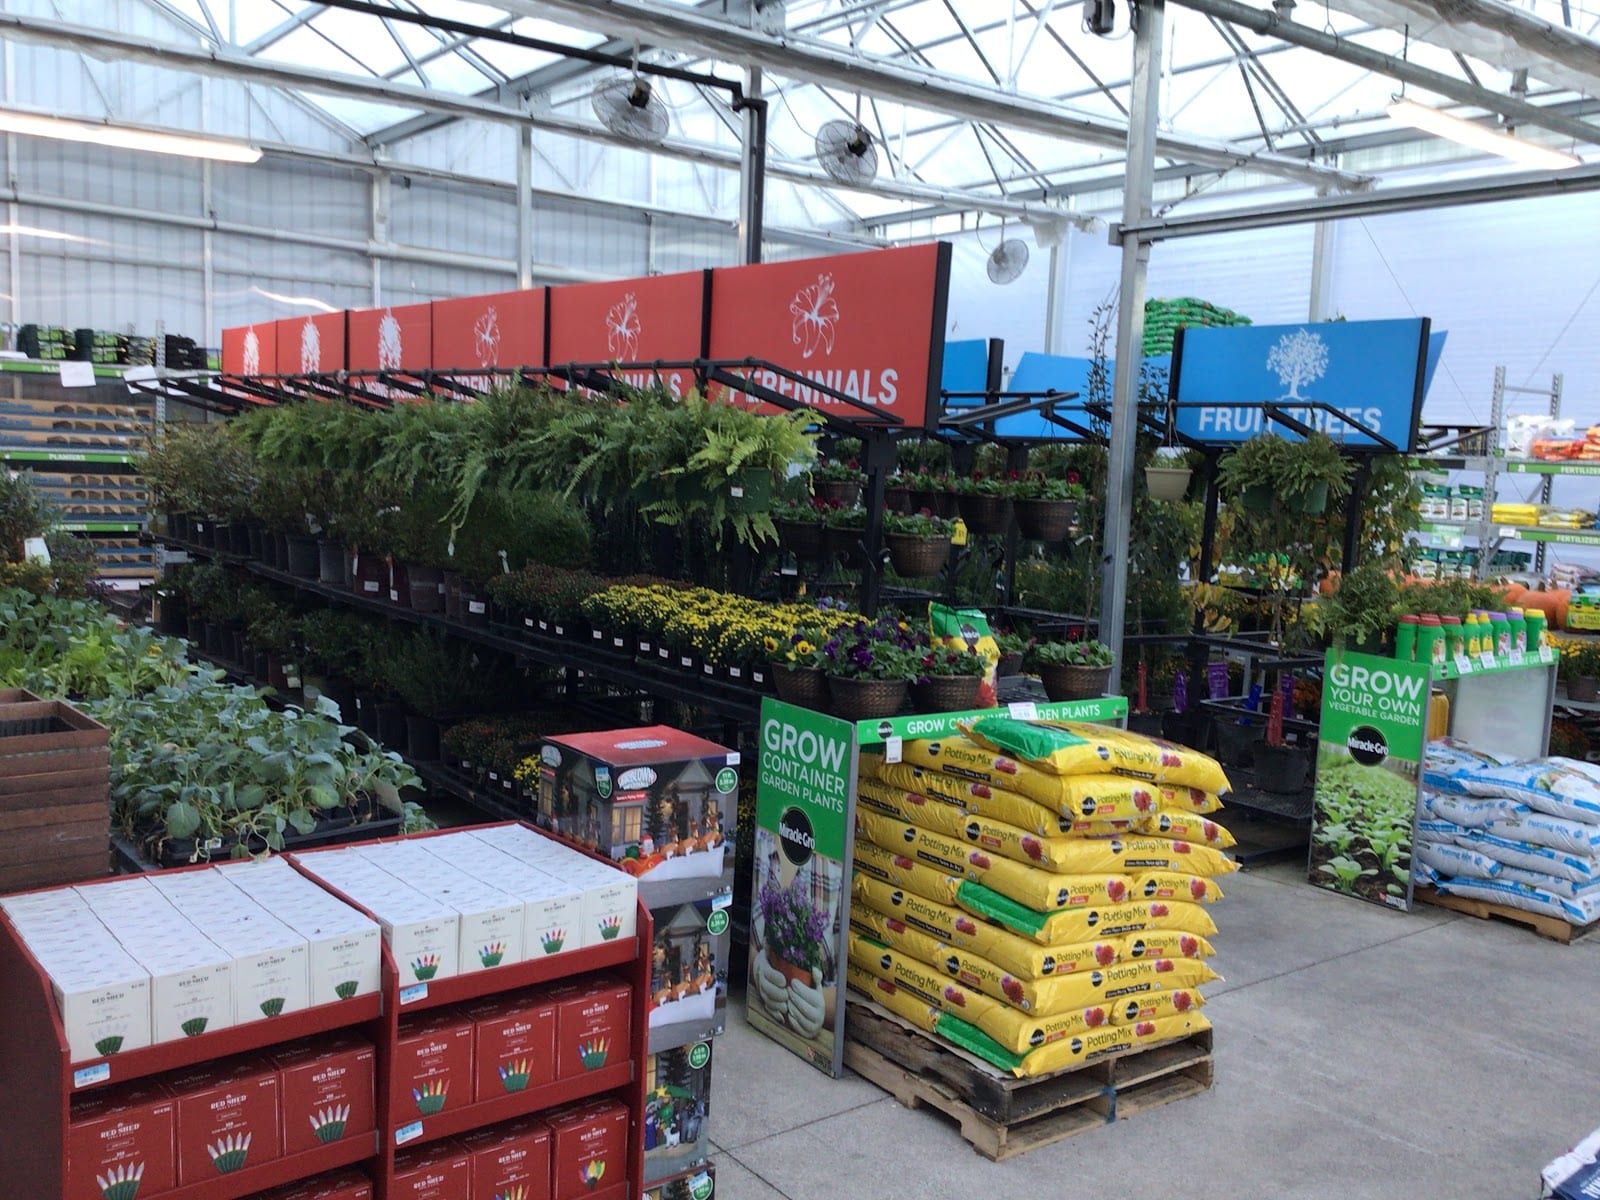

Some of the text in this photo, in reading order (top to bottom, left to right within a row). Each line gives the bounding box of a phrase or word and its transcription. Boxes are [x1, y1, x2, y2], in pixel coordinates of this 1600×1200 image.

[1330, 663, 1424, 700] GROW
[1330, 687, 1420, 716] YOUR OWN
[907, 720, 944, 735] GROW
[1062, 704, 1100, 719] PLANTS
[1329, 701, 1419, 726] VEGETABLE GARDEN
[764, 719, 847, 773] GROW
[1347, 736, 1389, 755] Miracle-Gro
[945, 747, 993, 765] Potting Mix
[763, 752, 845, 797] CONTAINER
[762, 771, 800, 798] GARDEN
[802, 788, 844, 814] PLANTS
[779, 822, 816, 850] Miracle-Gro
[982, 825, 1007, 842] Potting
[1007, 831, 1020, 843] Mix
[919, 834, 966, 858] Potting Mix
[1126, 839, 1170, 852] Potting Mix
[1070, 882, 1106, 895] Potting Mix
[906, 899, 952, 924] Potting Mix
[1103, 907, 1147, 922] Potting Mix
[1057, 947, 1093, 963] Potting Mix
[895, 962, 925, 987] Potting
[925, 977, 941, 993] Mix
[961, 961, 1000, 984] Potting Mix
[1107, 962, 1152, 982] Potting Mix
[1045, 1014, 1083, 1033] Potting Mix
[1087, 1028, 1132, 1048] Potting Mix
[312, 1067, 346, 1082] RED SHED
[210, 1095, 247, 1110] RED SHED
[100, 1123, 140, 1139] RED SHED
